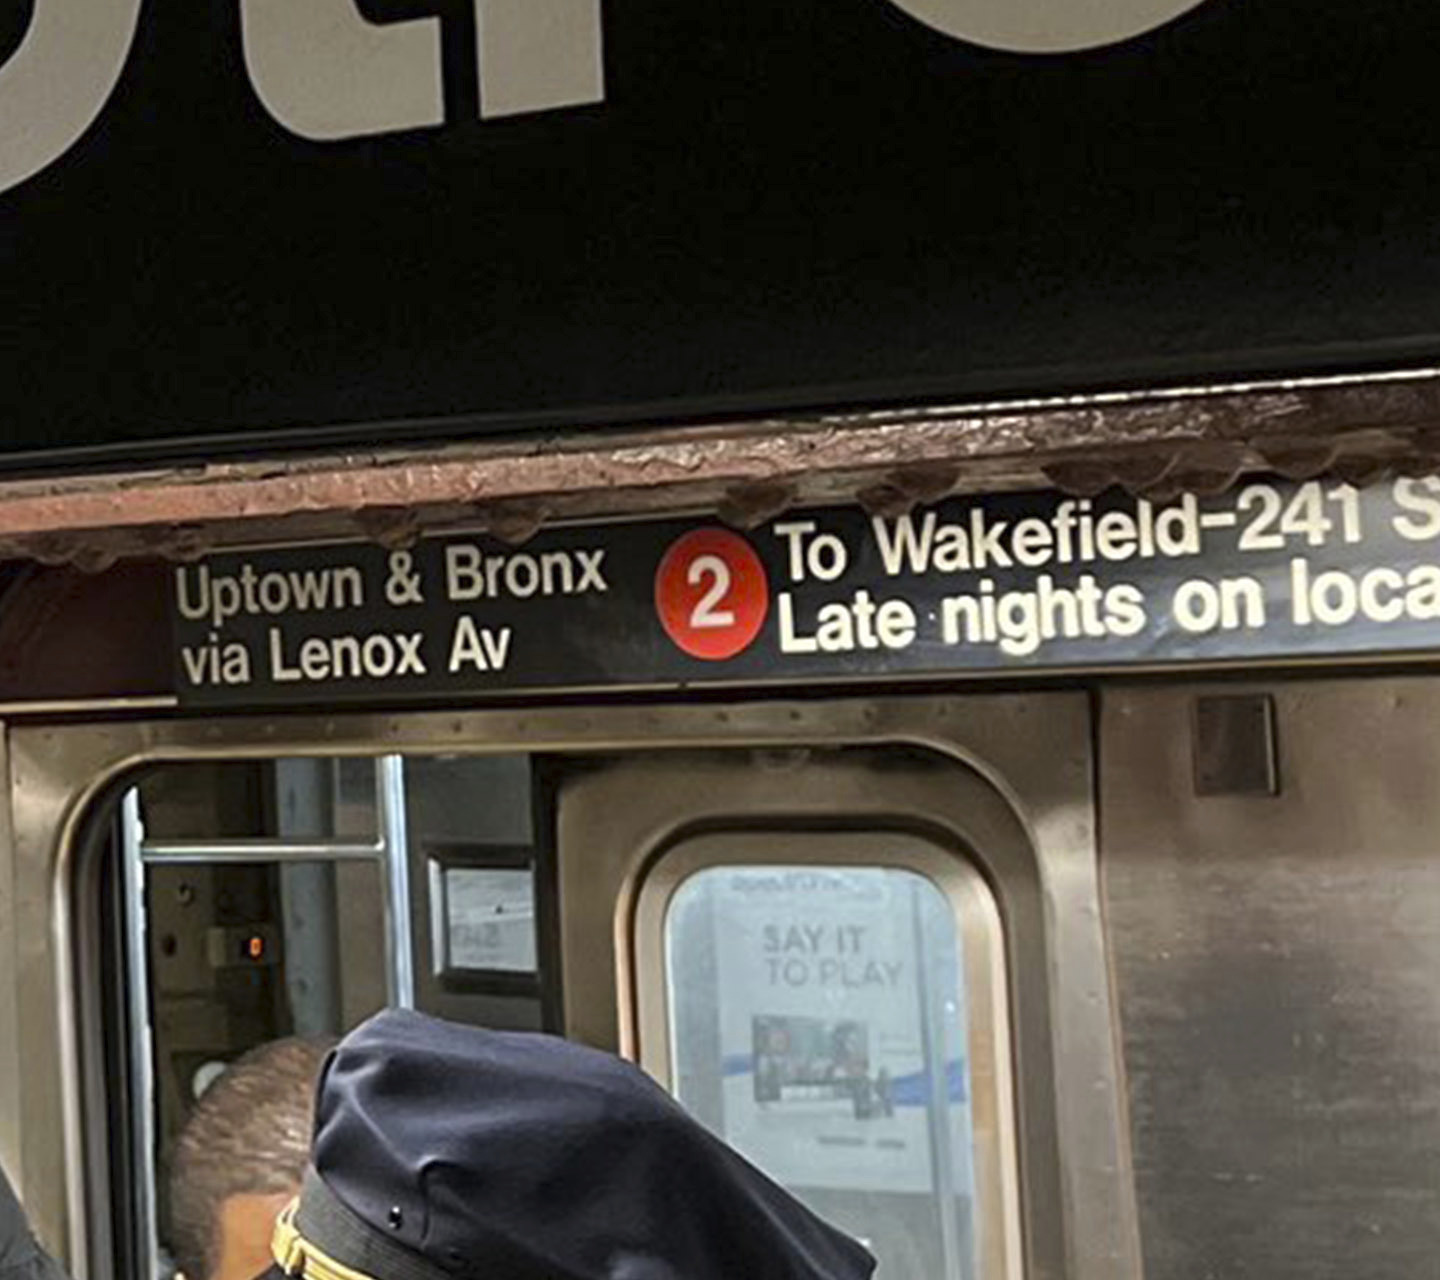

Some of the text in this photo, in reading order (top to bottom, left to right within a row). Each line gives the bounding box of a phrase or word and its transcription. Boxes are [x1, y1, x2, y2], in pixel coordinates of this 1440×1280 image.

[176, 542, 608, 626] Uptown & Bronx
[773, 520, 848, 583] To
[686, 554, 735, 629] 2
[776, 588, 917, 655] Late
[941, 573, 1147, 656] nights
[1172, 573, 1265, 634] on
[182, 614, 512, 686] via Lenox Av
[763, 923, 868, 955] SAY IT
[765, 958, 904, 989] TO PLAY
